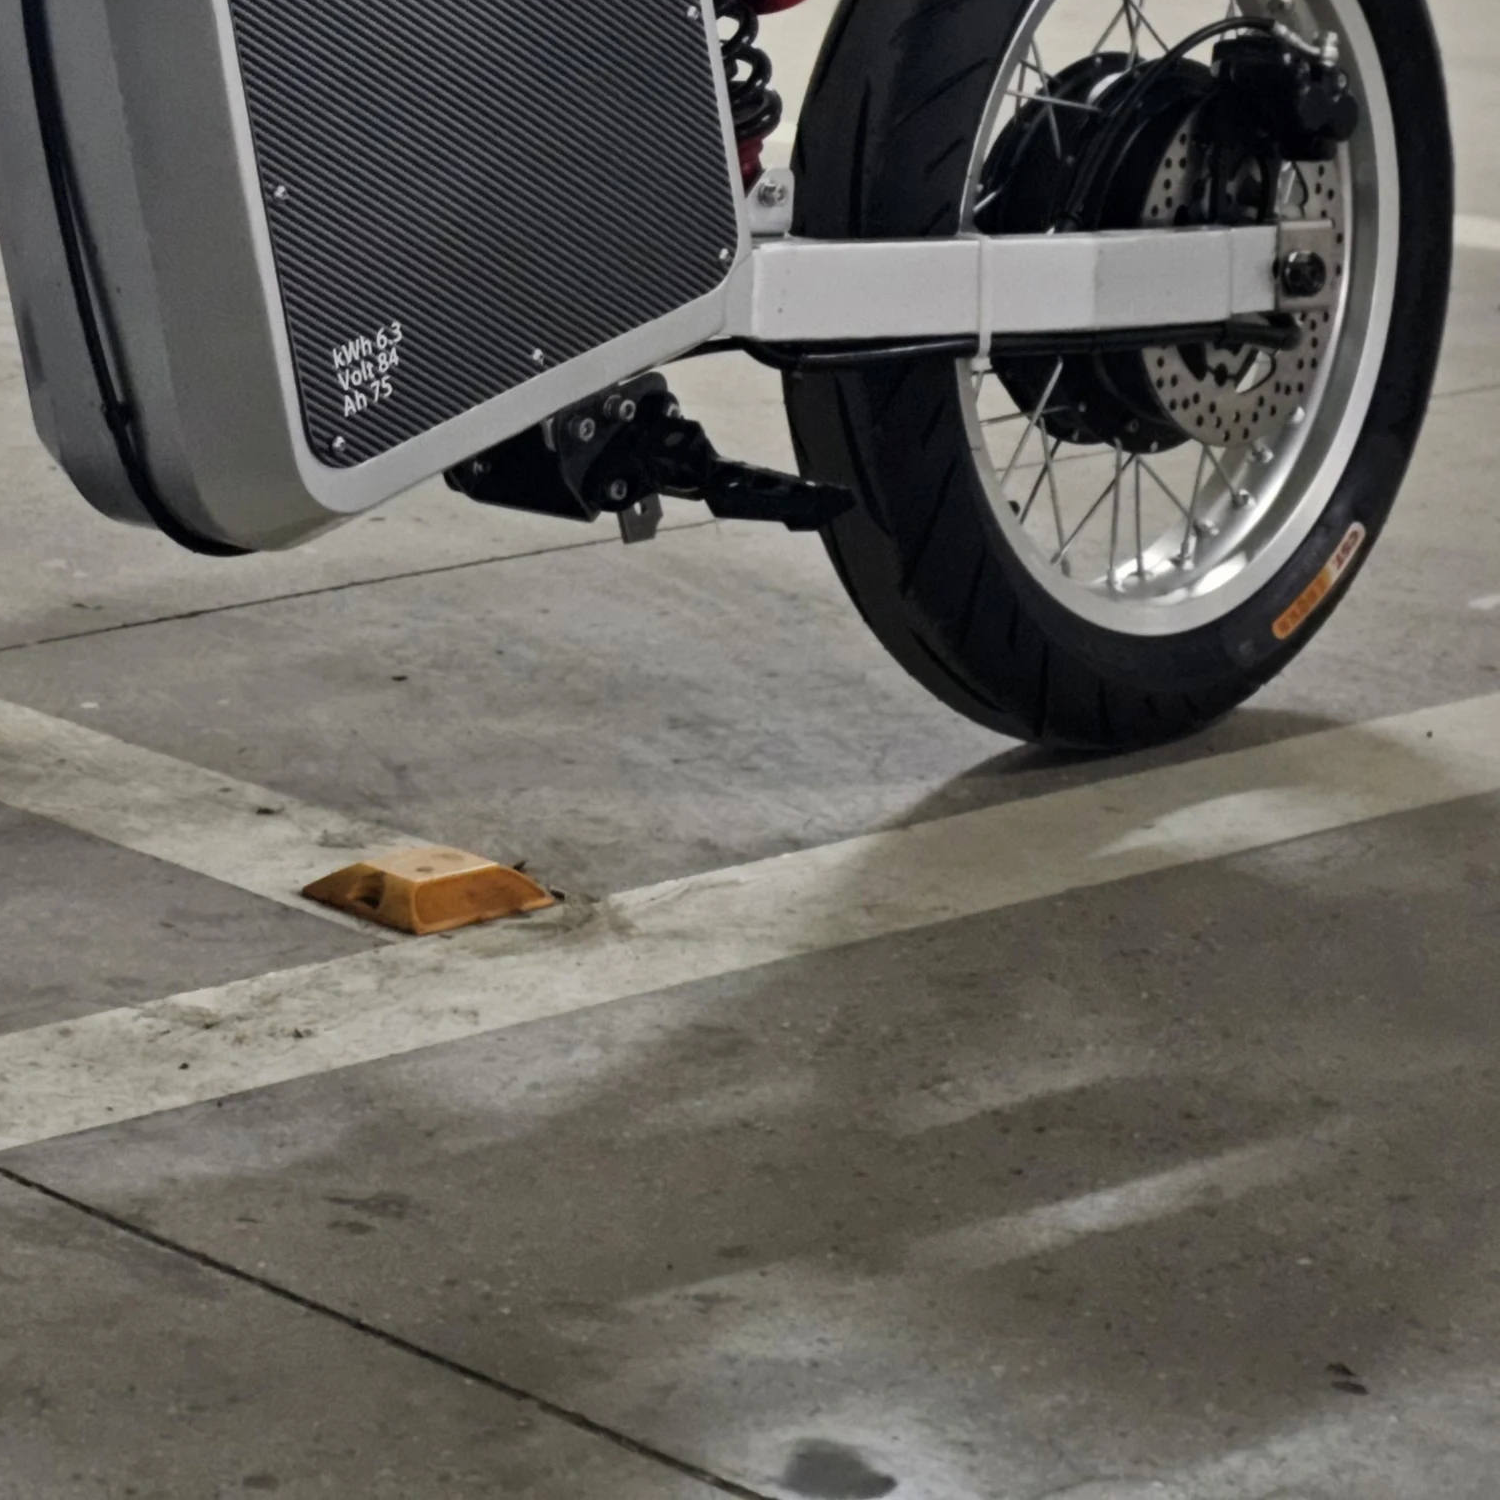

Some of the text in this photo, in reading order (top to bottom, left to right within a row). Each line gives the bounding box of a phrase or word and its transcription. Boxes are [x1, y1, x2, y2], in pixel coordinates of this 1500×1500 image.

[333, 321, 402, 368] kWh 6.3
[337, 347, 399, 391] Volt 84
[344, 375, 393, 417] Ah 75
